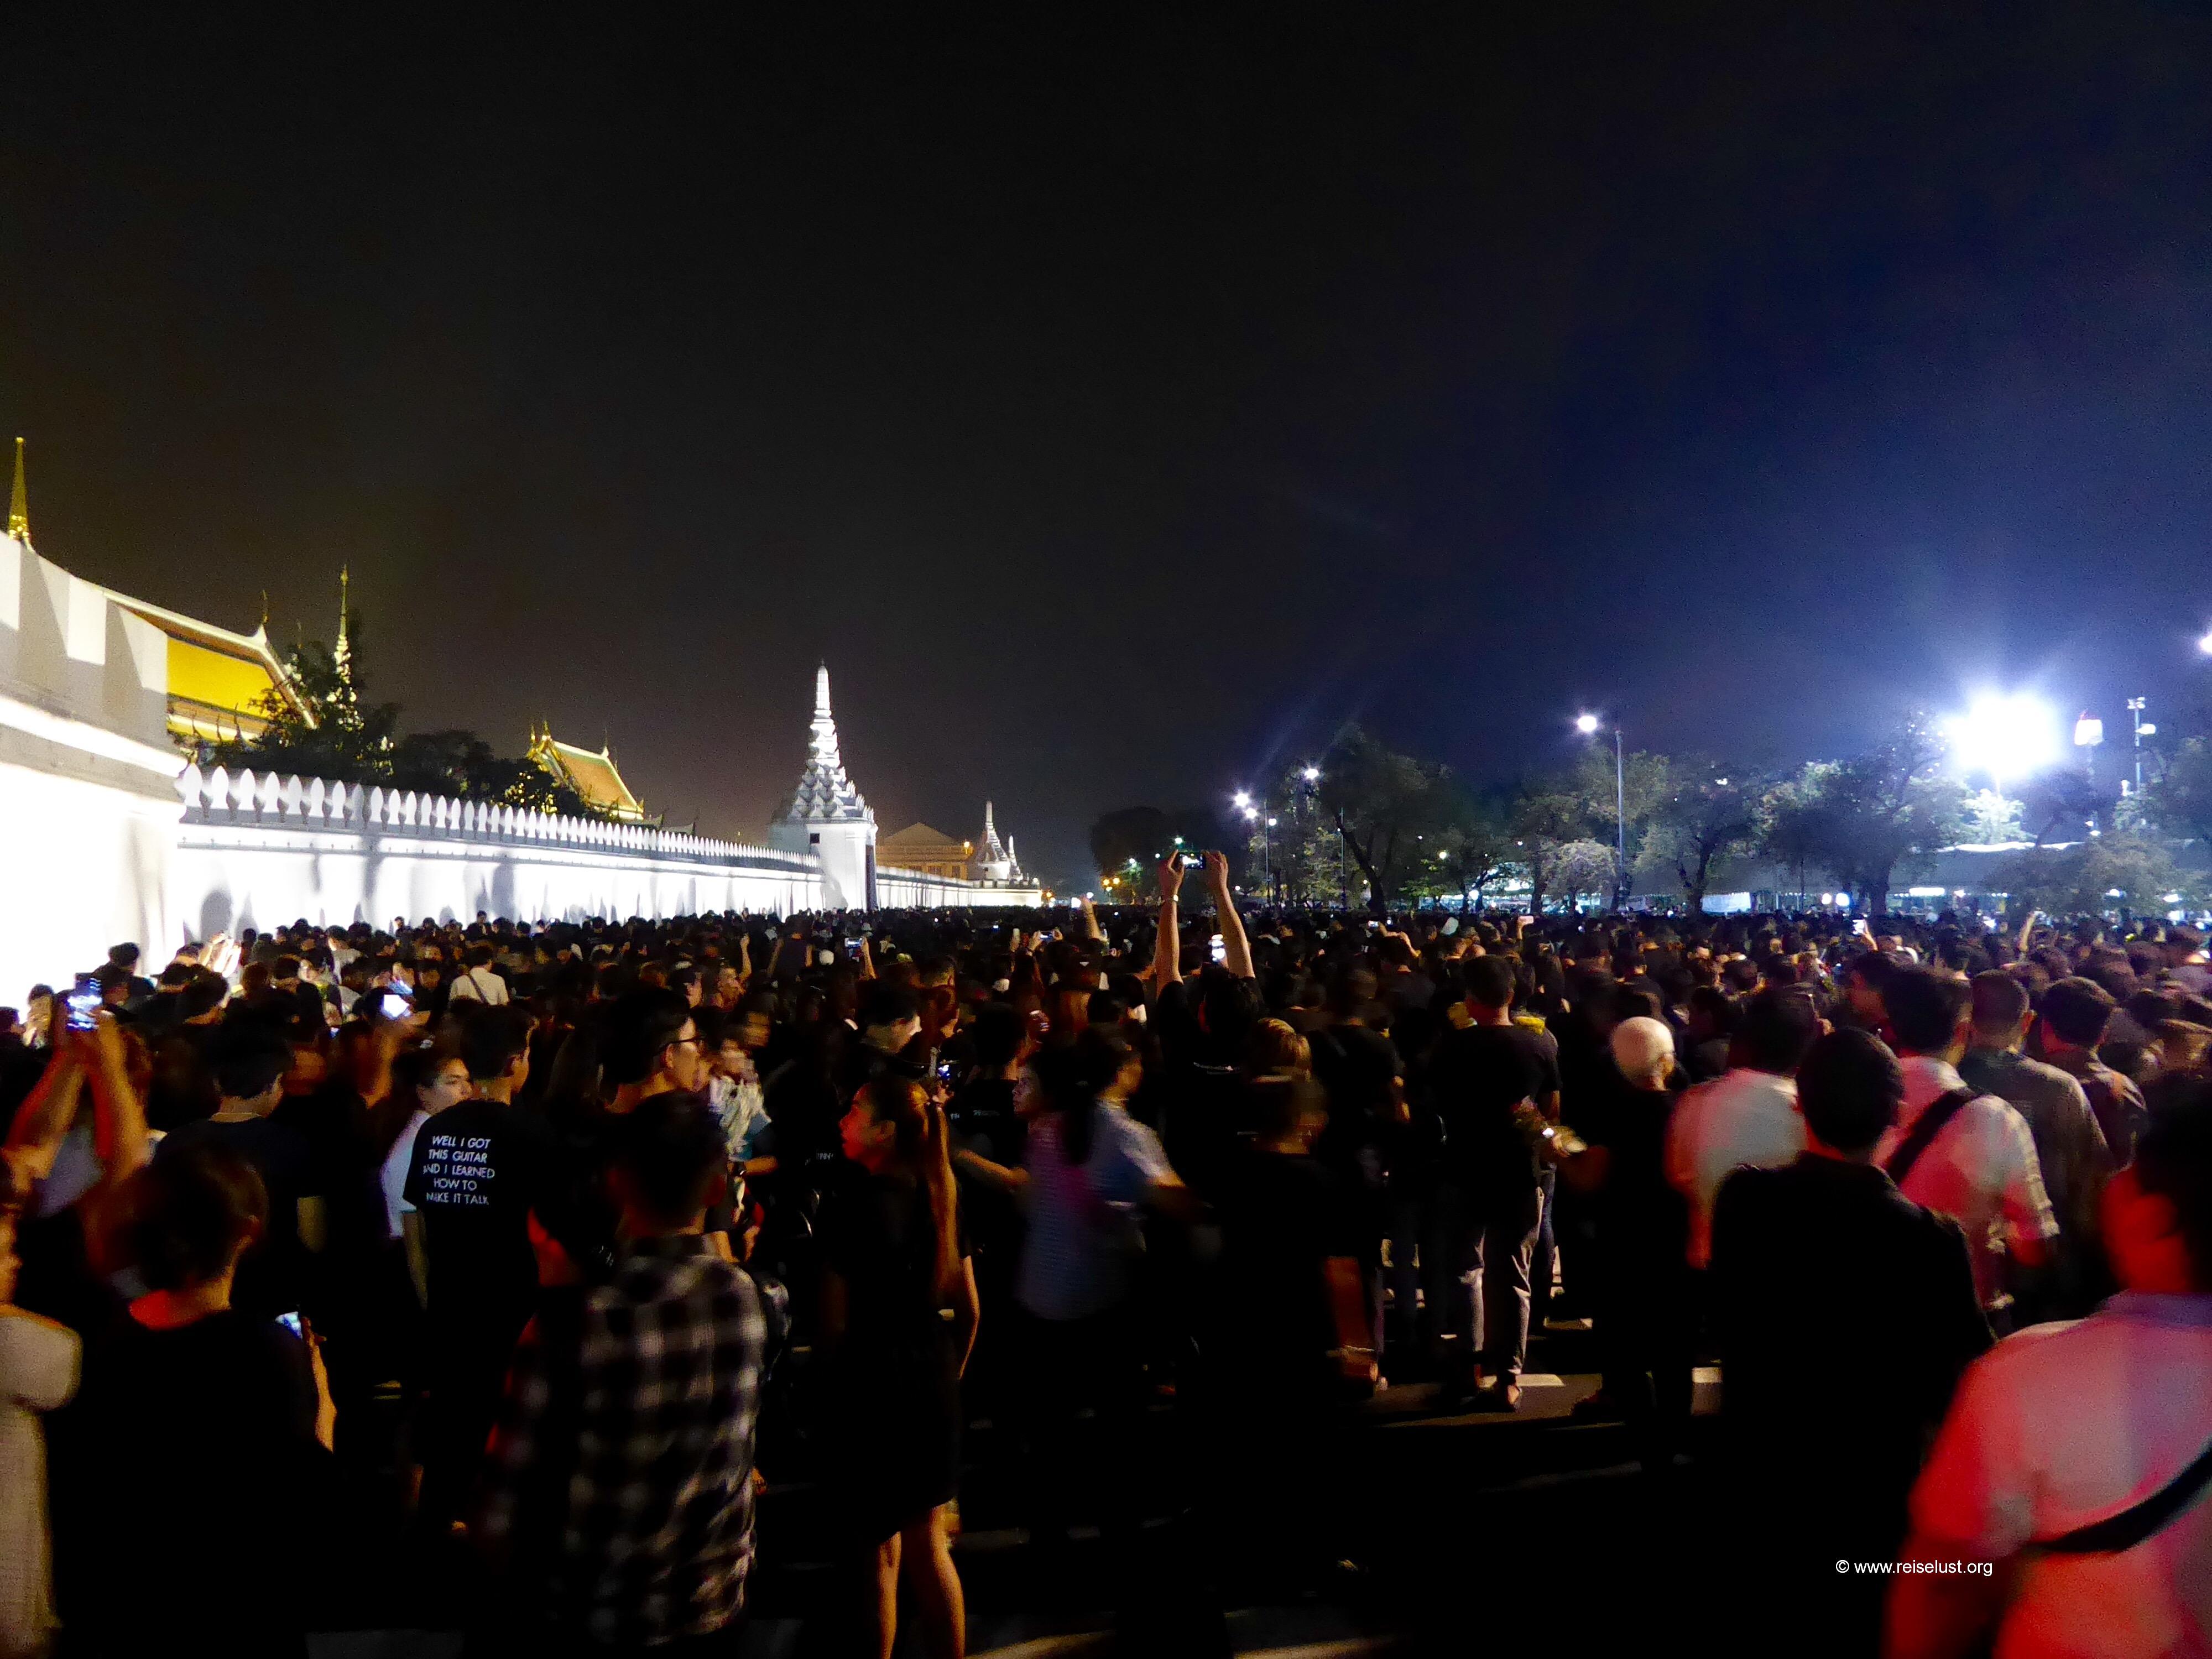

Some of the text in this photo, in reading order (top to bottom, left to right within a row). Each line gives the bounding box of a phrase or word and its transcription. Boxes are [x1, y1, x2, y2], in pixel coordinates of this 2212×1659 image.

[432, 1135, 491, 1149] WELL I GOT
[429, 1149, 487, 1164] THIS GUITAR
[444, 1164, 447, 1174] I
[452, 1165, 495, 1178] LEARNED
[434, 1178, 477, 1191] HOW TO
[453, 1193, 462, 1203] IT
[464, 1194, 489, 1205] TALK
